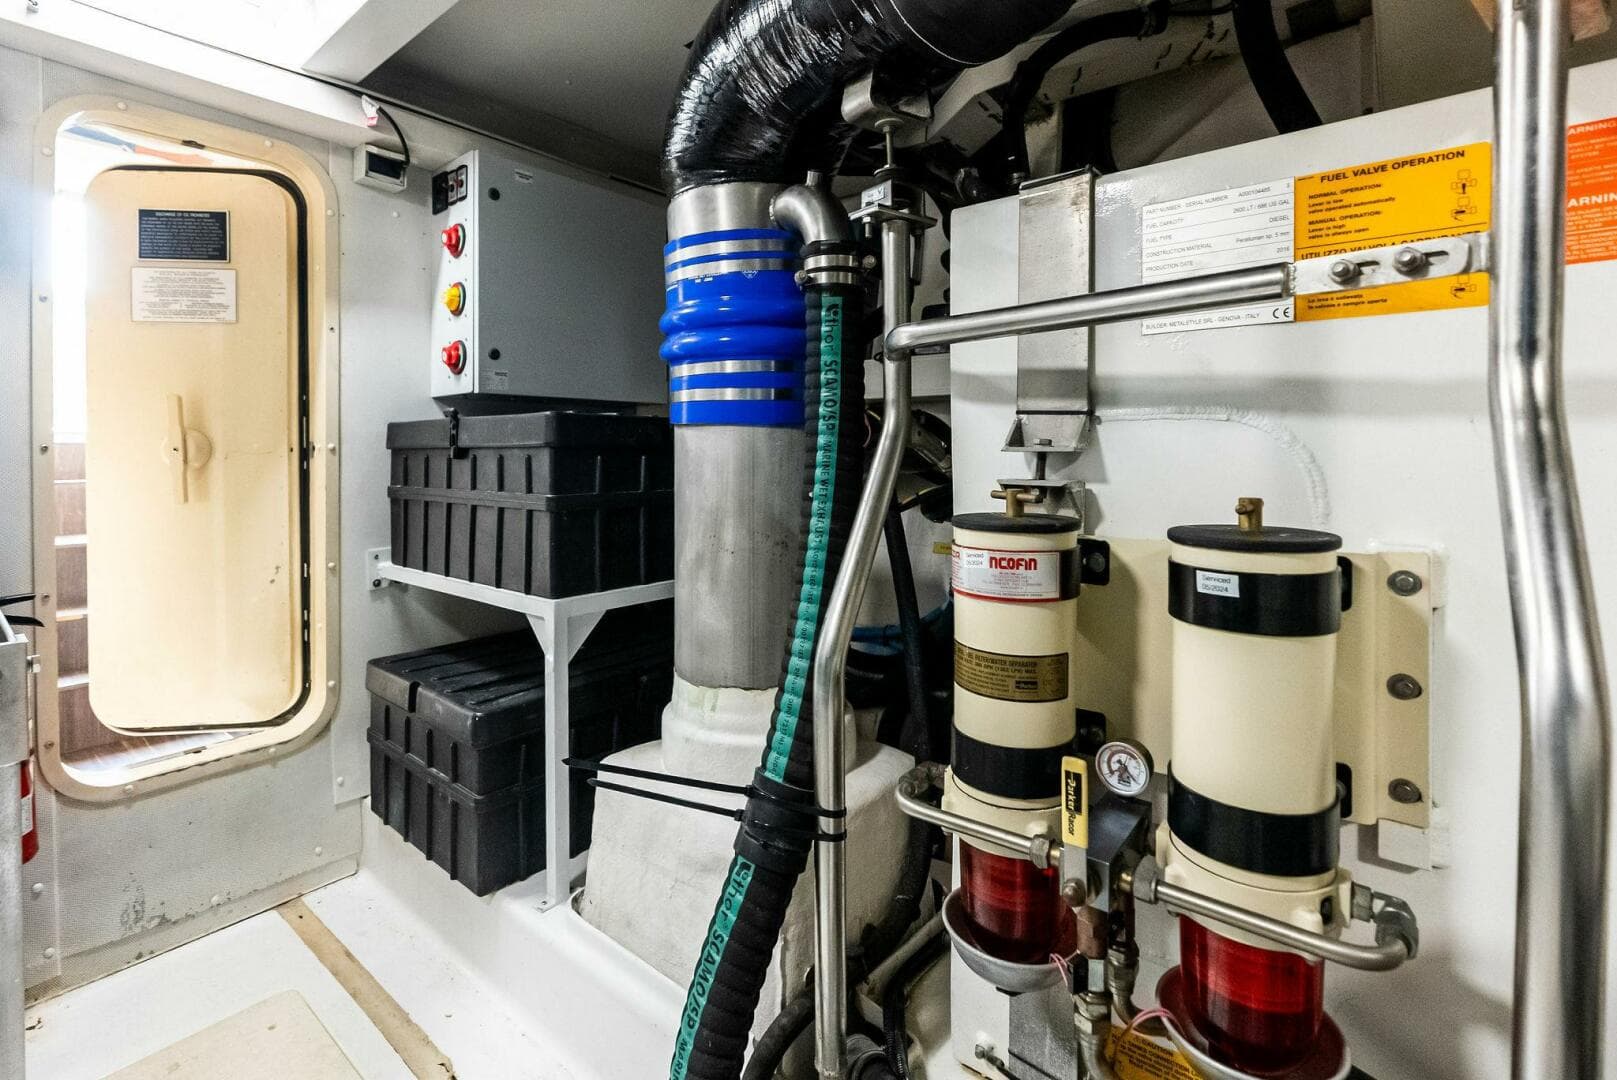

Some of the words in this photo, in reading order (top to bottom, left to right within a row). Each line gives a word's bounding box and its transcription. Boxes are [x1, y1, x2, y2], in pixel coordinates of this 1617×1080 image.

[1567, 120, 1617, 135] ARNING
[1320, 172, 1349, 183] FUEL
[1352, 164, 1389, 177] VALVE
[1391, 150, 1465, 170] OPERATION
[1308, 191, 1338, 200] NORMAL
[1567, 192, 1617, 208] ARNIN
[1160, 204, 1181, 213] NUMBER
[1185, 199, 1204, 208] SERIAL
[1205, 195, 1228, 203] NUMBER
[1325, 203, 1352, 213] operated
[1353, 196, 1395, 208] automatically
[1145, 221, 1159, 229] FUEL
[1159, 218, 1184, 227] CAPACITY
[1269, 214, 1290, 223] DIESEL
[1308, 217, 1338, 225] MANUAL
[1332, 230, 1352, 238] always
[1145, 246, 1186, 259] CONSTRUCTION
[1186, 243, 1212, 252] MATERIAL
[1145, 262, 1179, 272] PRODUCTION
[1218, 314, 1241, 323] GENOVA
[822, 360, 838, 431] SCAMO/SP
[820, 443, 832, 476] MARINE
[818, 479, 829, 498] WET
[815, 500, 827, 544] EXHAUST
[1067, 778, 1077, 811] Parker
[687, 928, 725, 1030] SCAMO/SP
[671, 1038, 688, 1080] MARIN
